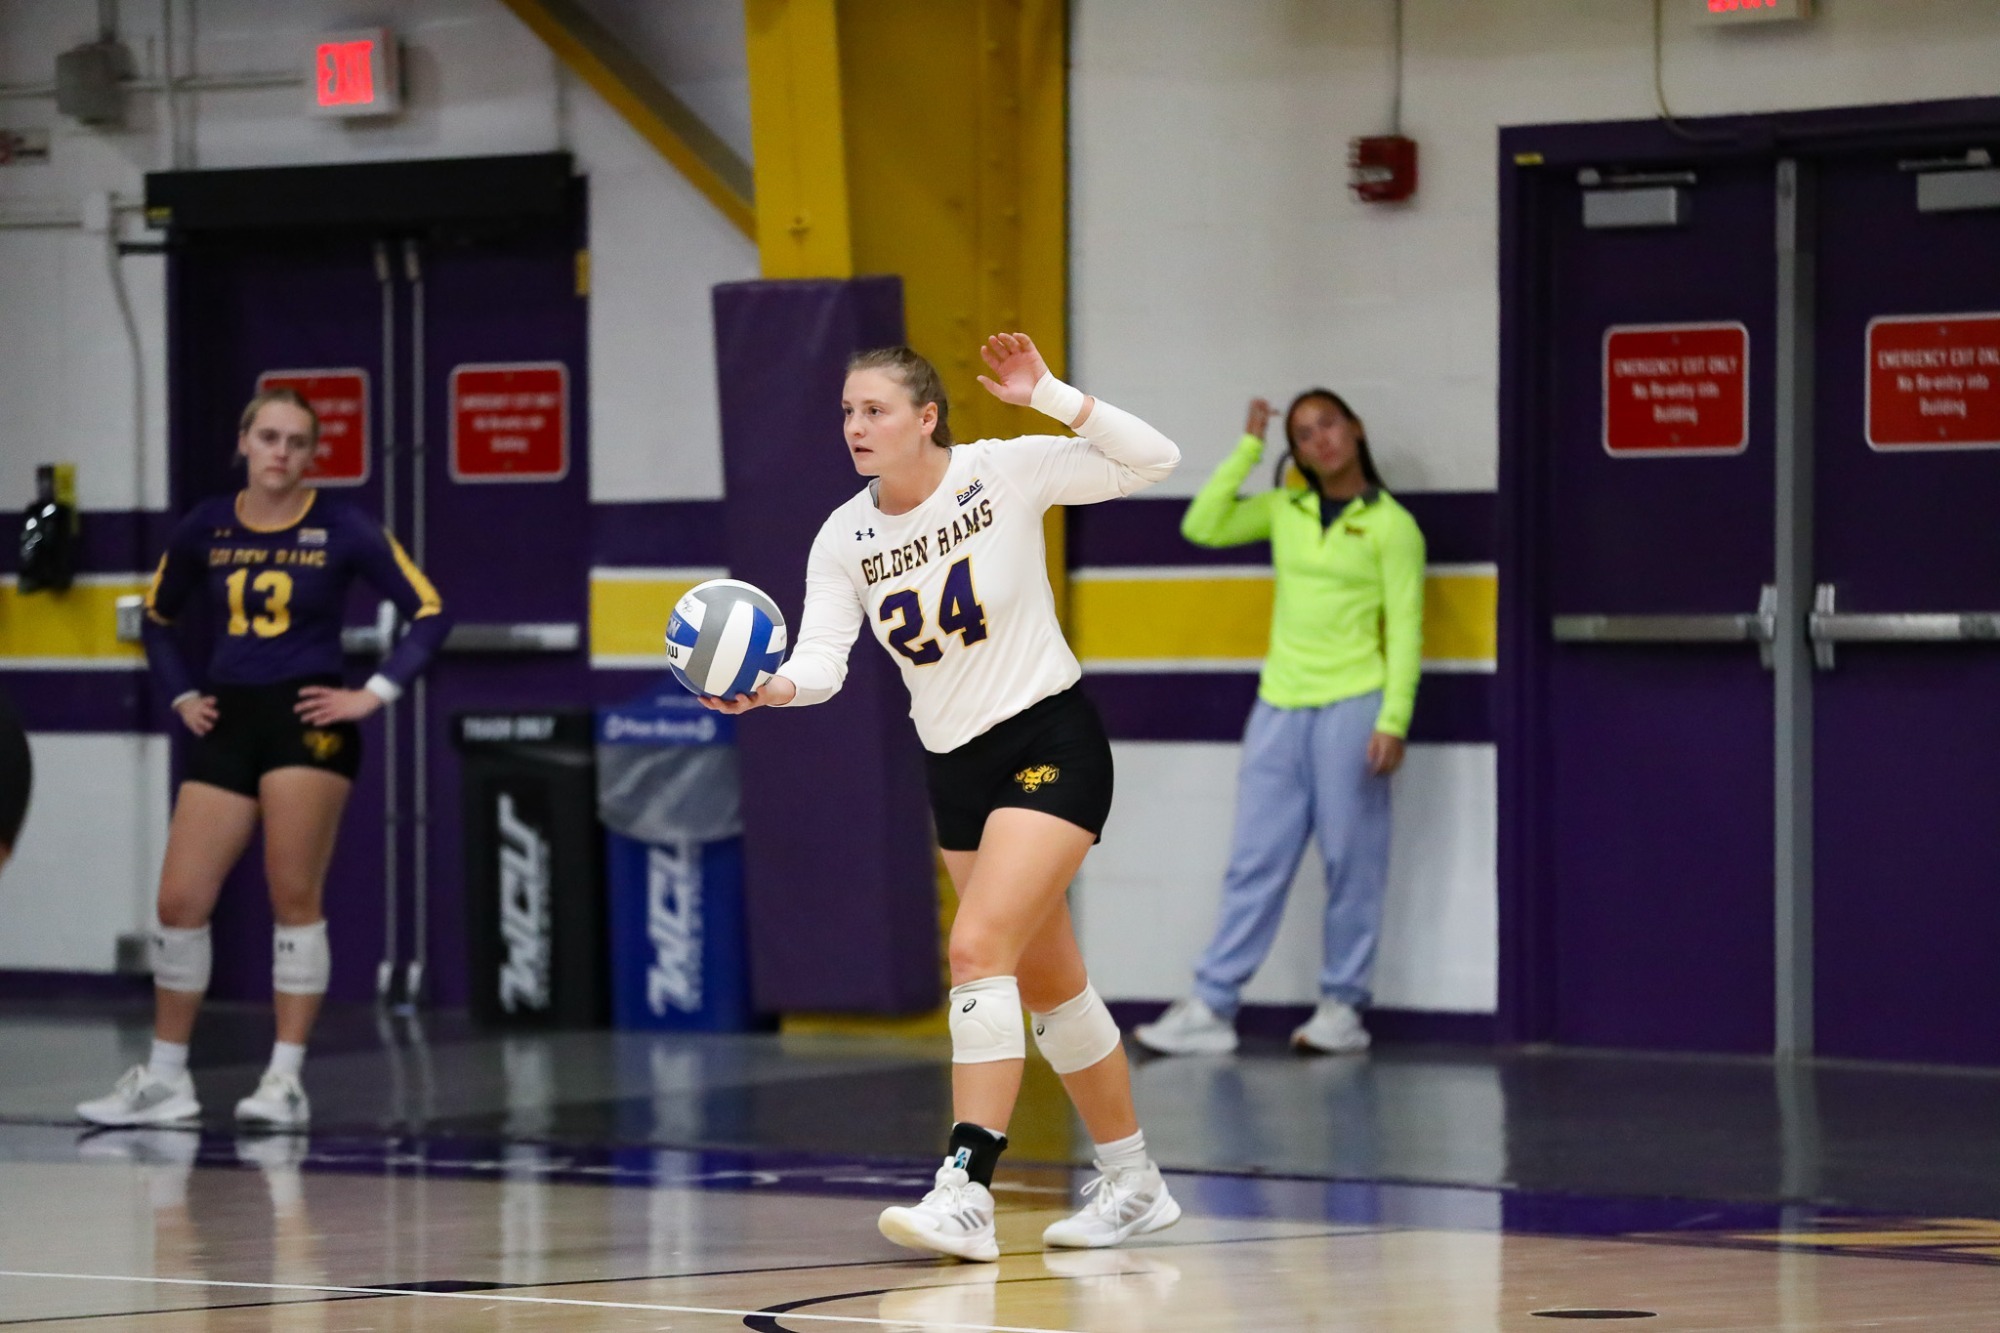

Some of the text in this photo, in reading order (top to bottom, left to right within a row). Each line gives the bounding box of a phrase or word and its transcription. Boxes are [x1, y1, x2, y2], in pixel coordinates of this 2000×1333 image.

[316, 40, 374, 106] EXIT
[861, 535, 929, 586] GOLDEN
[226, 567, 294, 638] 13
[879, 553, 988, 667] 24
